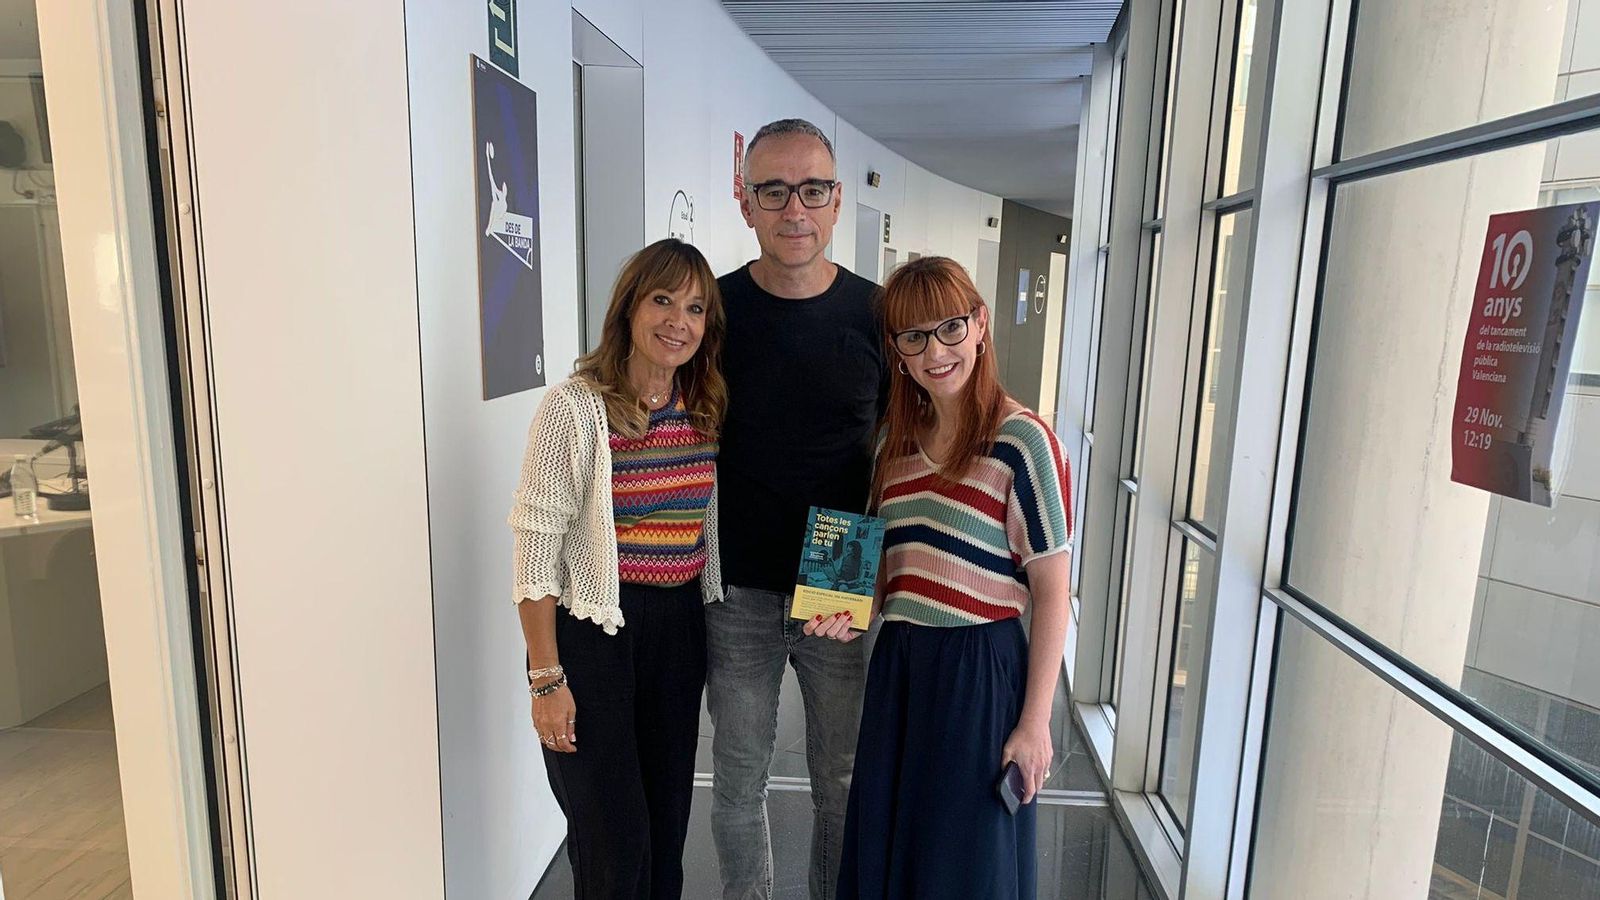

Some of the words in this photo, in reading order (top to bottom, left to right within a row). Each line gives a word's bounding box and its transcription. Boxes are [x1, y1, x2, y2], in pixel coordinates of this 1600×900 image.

[505, 221, 514, 233] DES
[515, 223, 521, 235] DE
[508, 236, 514, 247] LA
[515, 236, 530, 249] BANDA
[1489, 230, 1533, 290] 10
[1483, 297, 1523, 324] anys
[1480, 325, 1491, 335] del
[1491, 327, 1527, 337] tancament
[1477, 340, 1485, 350] de
[1486, 340, 1492, 351] la
[1493, 341, 1541, 354] radiotelevisió
[1474, 355, 1498, 367] pública
[1472, 370, 1507, 383] Valenciana
[1464, 406, 1479, 423] 29
[1479, 408, 1503, 428] Nov.
[1464, 430, 1492, 450] 12:19
[816, 513, 838, 524] Totes
[840, 517, 851, 526] les
[815, 522, 848, 534] cançons
[813, 530, 840, 540] parlen
[812, 537, 823, 545] de
[824, 539, 833, 547] tu
